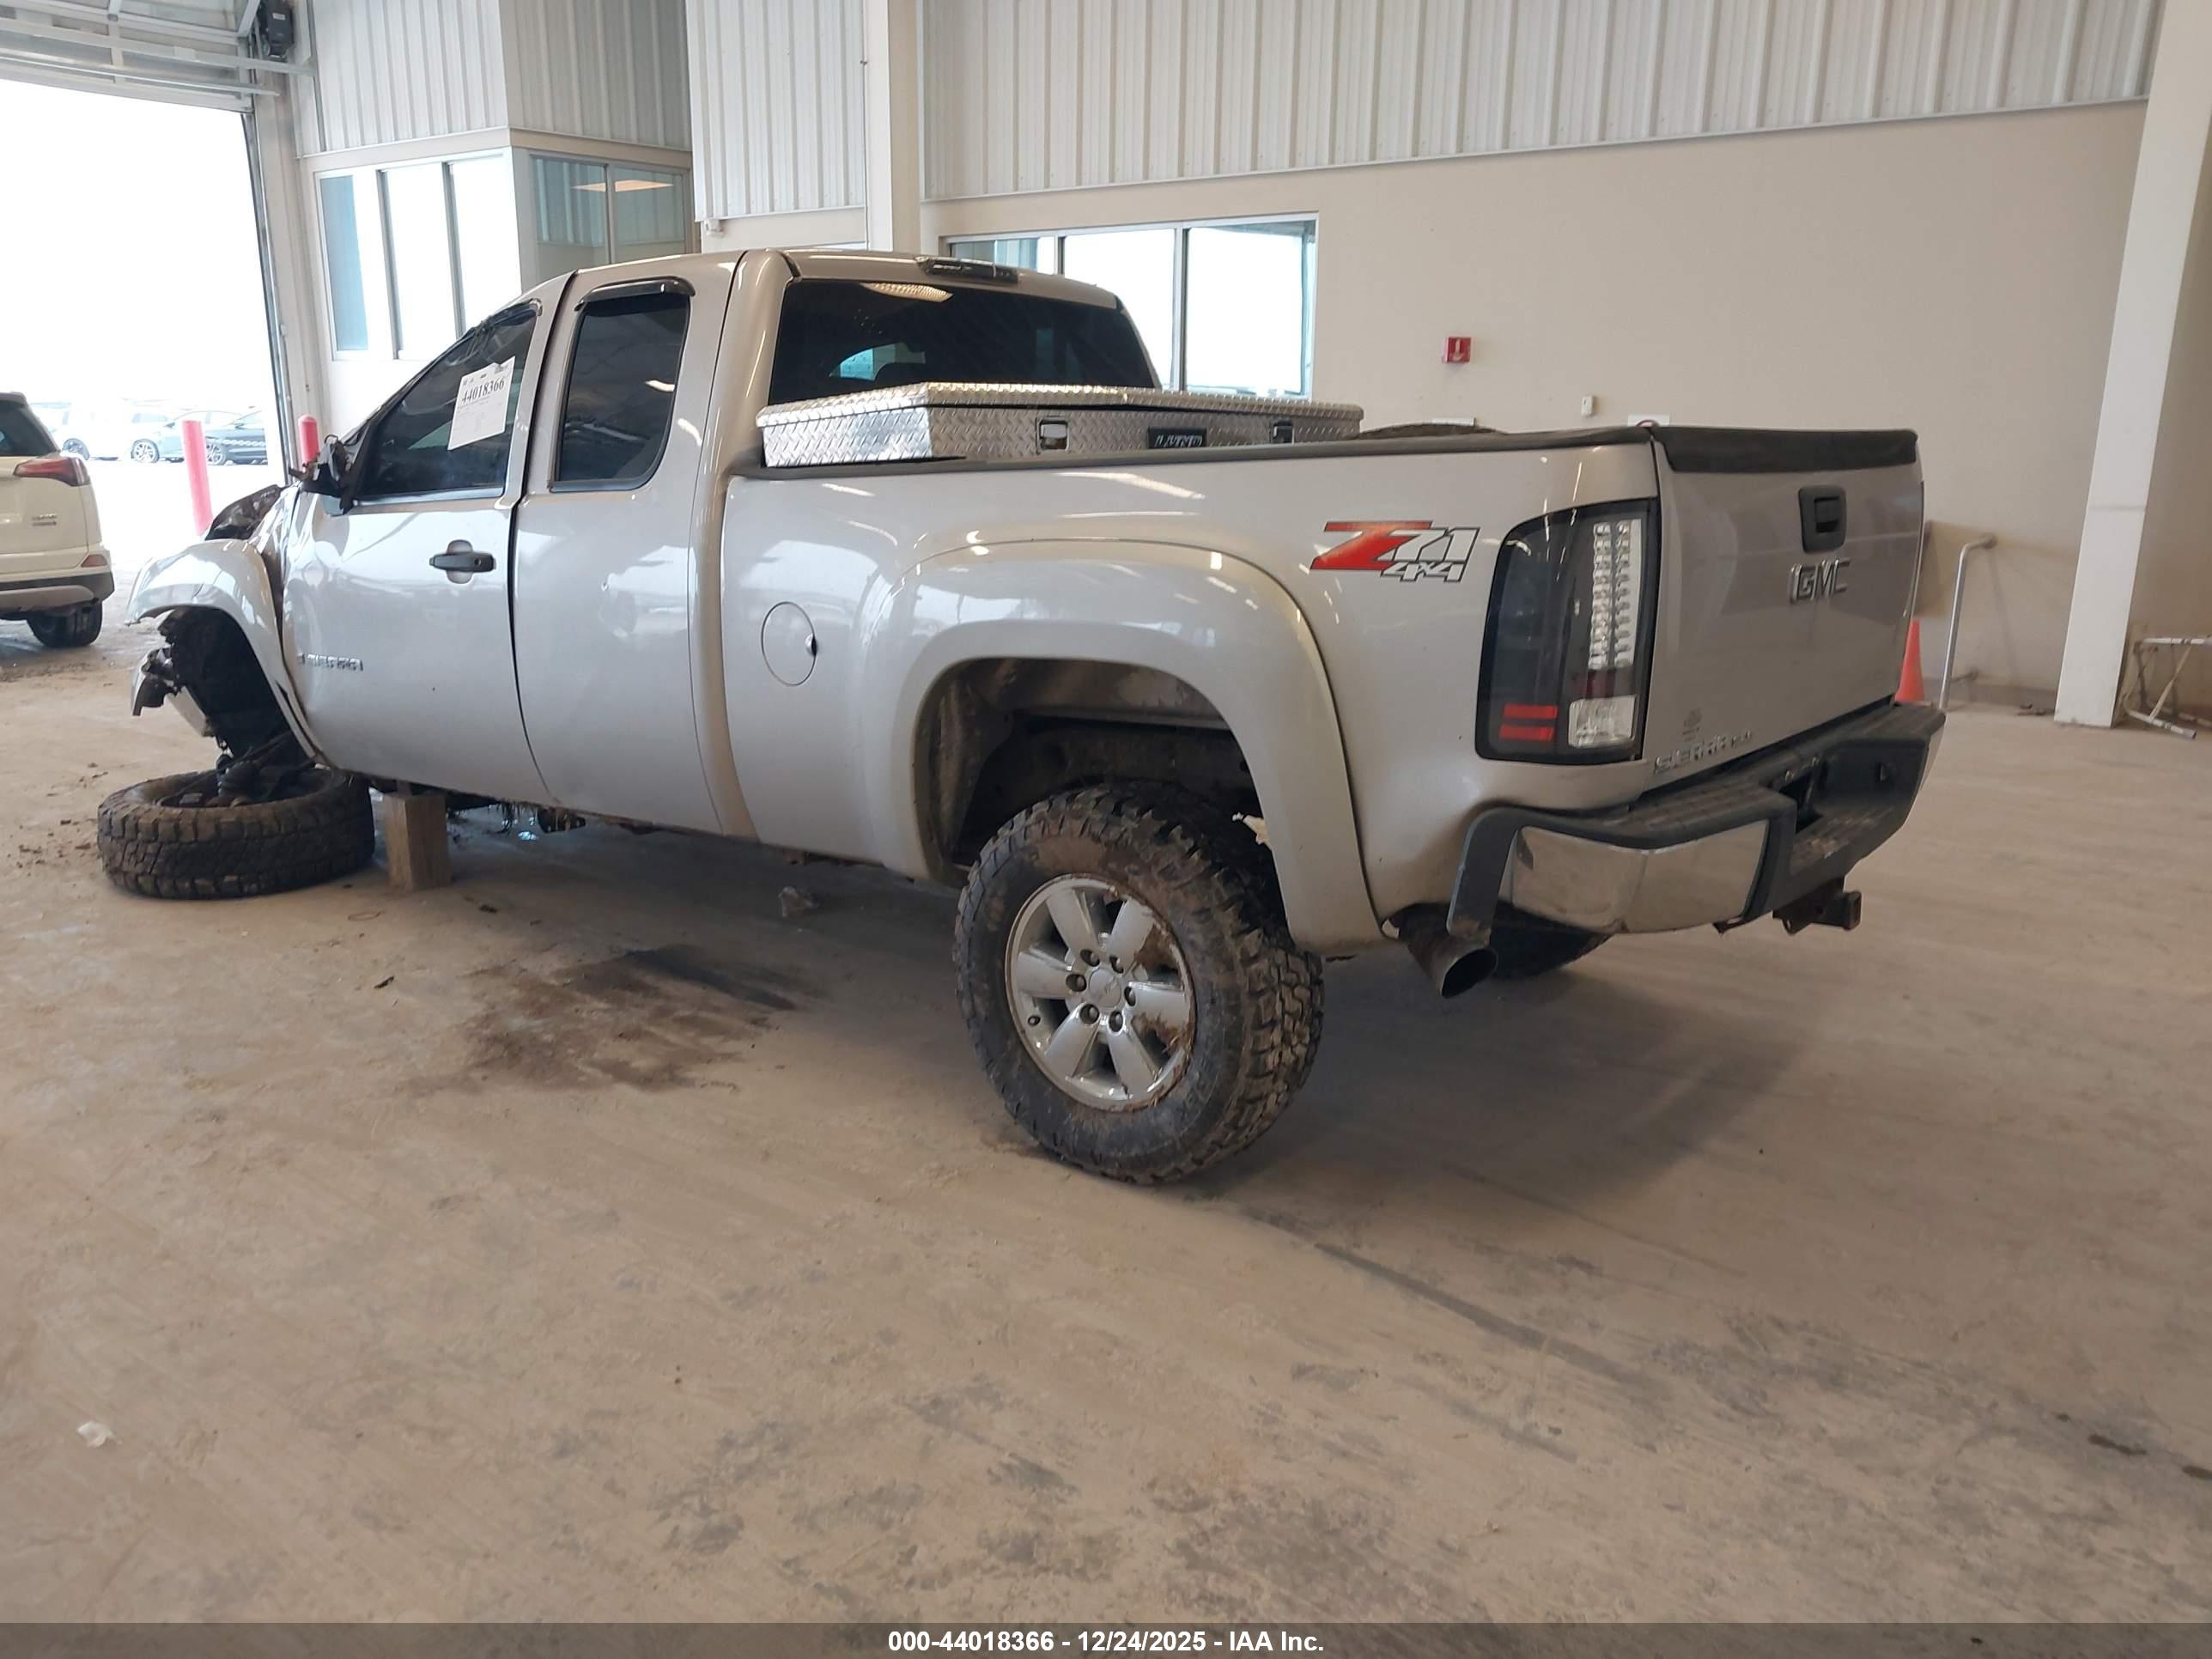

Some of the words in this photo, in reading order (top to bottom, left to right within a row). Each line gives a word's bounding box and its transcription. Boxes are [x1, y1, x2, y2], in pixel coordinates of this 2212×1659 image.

[461, 376, 505, 404] 44018366
[1310, 520, 1480, 570] Z71
[1786, 557, 1851, 605] GMC
